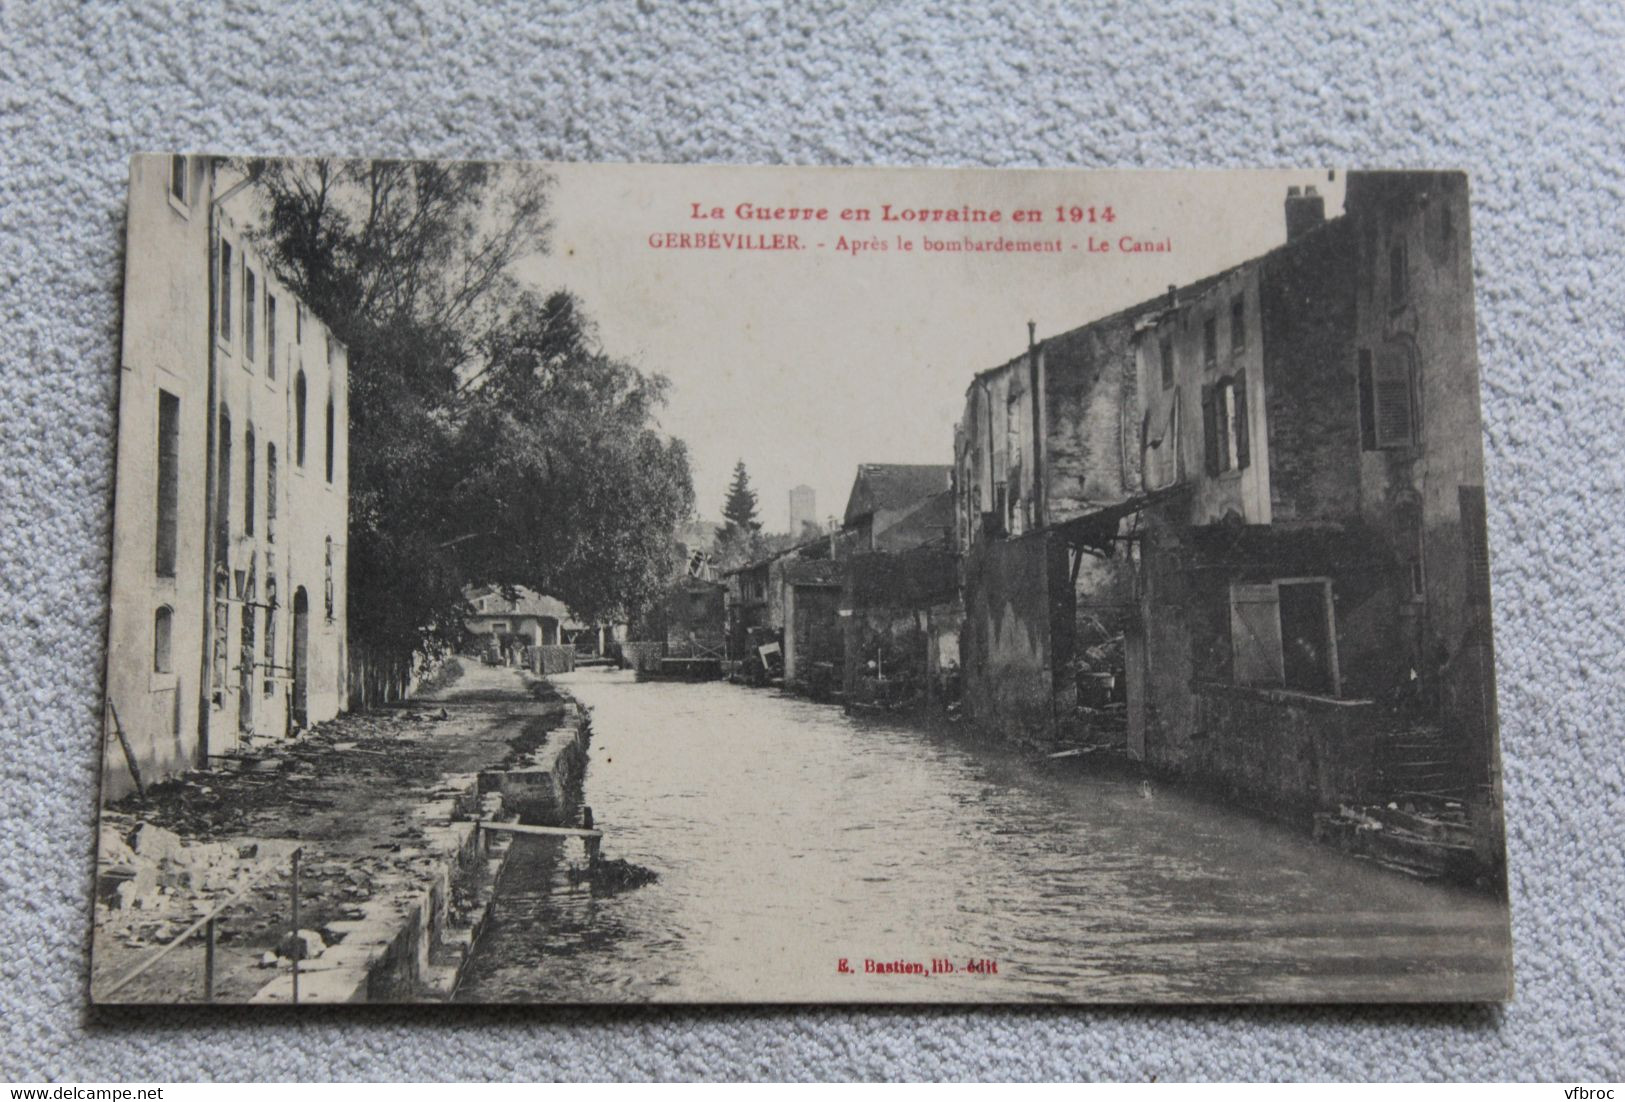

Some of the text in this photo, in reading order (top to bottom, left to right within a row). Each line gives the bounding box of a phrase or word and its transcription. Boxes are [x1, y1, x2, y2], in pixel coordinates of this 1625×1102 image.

[690, 202, 1117, 224] La Guerre en Lorraine en 1914
[647, 230, 807, 251] GERBÉVILLER.
[835, 234, 890, 257] Après
[898, 235, 914, 252] le
[923, 235, 1063, 254] bombardement
[1088, 236, 1111, 254] Le
[1118, 235, 1173, 254] Canal
[837, 957, 856, 975] E.
